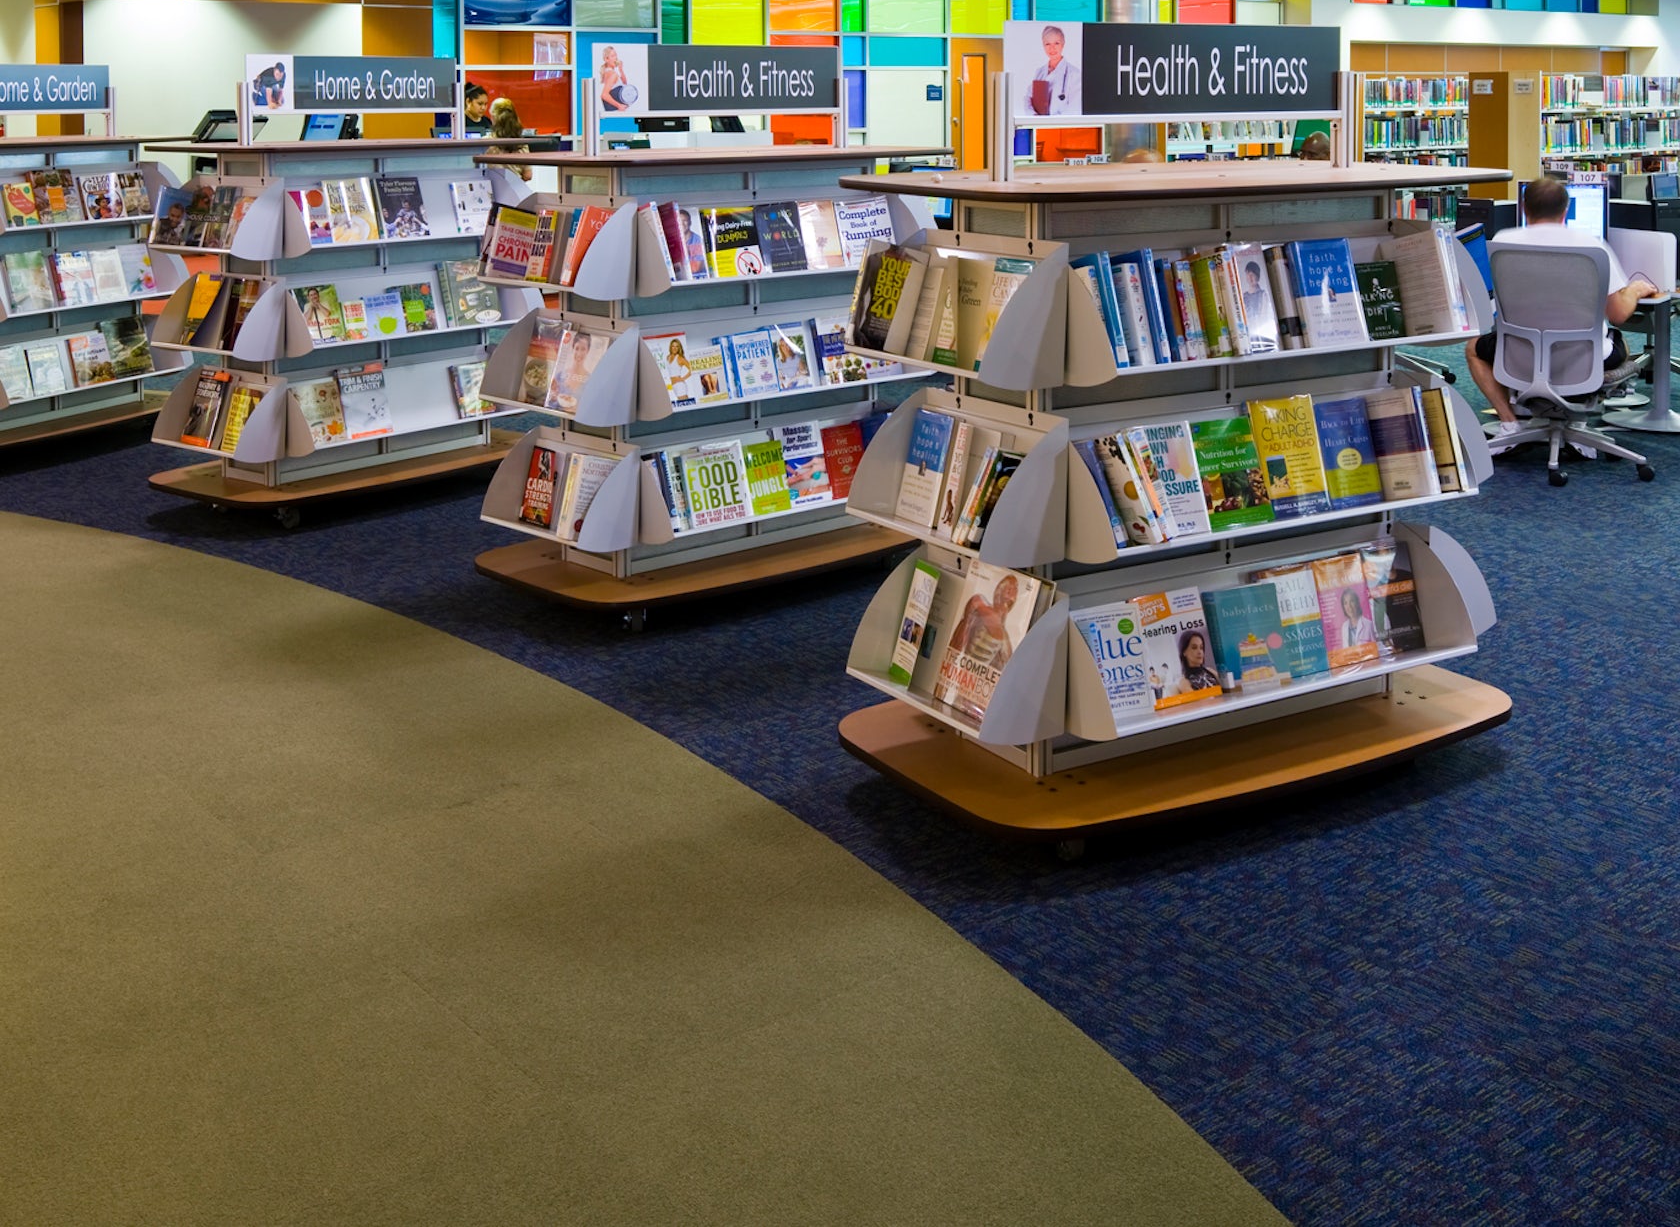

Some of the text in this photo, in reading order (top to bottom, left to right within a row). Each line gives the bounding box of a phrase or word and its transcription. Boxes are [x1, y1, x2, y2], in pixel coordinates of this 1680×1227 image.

[1117, 44, 1308, 96] Health & Fitness
[315, 69, 436, 101] Home & Garden
[674, 60, 814, 98] Health & Fitness
[0, 75, 97, 103] ome & Garden
[1580, 174, 1596, 182] 107
[327, 183, 357, 195] Perect
[330, 204, 366, 215] Setngs
[839, 207, 886, 220] Complete
[501, 225, 515, 233] TAKE
[590, 219, 603, 230] YO
[850, 221, 869, 229] Book
[717, 230, 748, 244] DUMMIES
[763, 228, 800, 241] WORLD
[846, 227, 892, 241] Running
[495, 243, 530, 263] PAIN
[1309, 253, 1336, 263] faith
[882, 255, 912, 274] YOUR
[1309, 267, 1333, 277] hope
[993, 274, 1009, 288] LIFE
[1309, 277, 1350, 289] heing
[874, 283, 903, 300] BOD
[993, 286, 1011, 299] CAN
[870, 297, 897, 320] 40
[324, 317, 341, 326] FORK
[738, 348, 770, 360] PATIENT
[340, 374, 383, 388] TRIM & FINISH
[344, 381, 381, 394] CARPENTRY
[1261, 406, 1306, 425] TAKING
[782, 424, 812, 436] Massage
[922, 423, 940, 436] faith
[1149, 425, 1185, 441] INGING
[1261, 422, 1313, 442] CHARGE
[786, 433, 812, 444] for Sport
[836, 437, 848, 446] THE
[916, 437, 934, 449] hope
[1269, 438, 1315, 453] ADULT ADHD
[783, 441, 818, 453] Performance
[827, 445, 862, 458] SURVIVORS
[1150, 441, 1169, 455] WN
[1200, 446, 1246, 460] Nutrition for
[744, 447, 783, 469] WELCOME
[837, 457, 854, 465] CLUB
[912, 449, 939, 465] healing
[754, 464, 780, 480] TO THE
[1199, 458, 1258, 472] ancer Survivors
[686, 460, 738, 491] FOOD
[751, 473, 789, 500] JUNGLE
[1165, 479, 1201, 496] SSURE
[690, 483, 743, 512] BIBLE
[723, 506, 737, 515] FOOD
[1139, 604, 1166, 618] DIOT'S
[1222, 603, 1275, 618] babyfacts
[1280, 595, 1316, 613] HEEHY
[1179, 617, 1205, 631] Loss
[1284, 625, 1323, 643] SSAGES
[1096, 628, 1144, 660] lue
[946, 650, 960, 665] THE
[940, 661, 978, 692] HUMAN
[1103, 662, 1145, 683] ones
